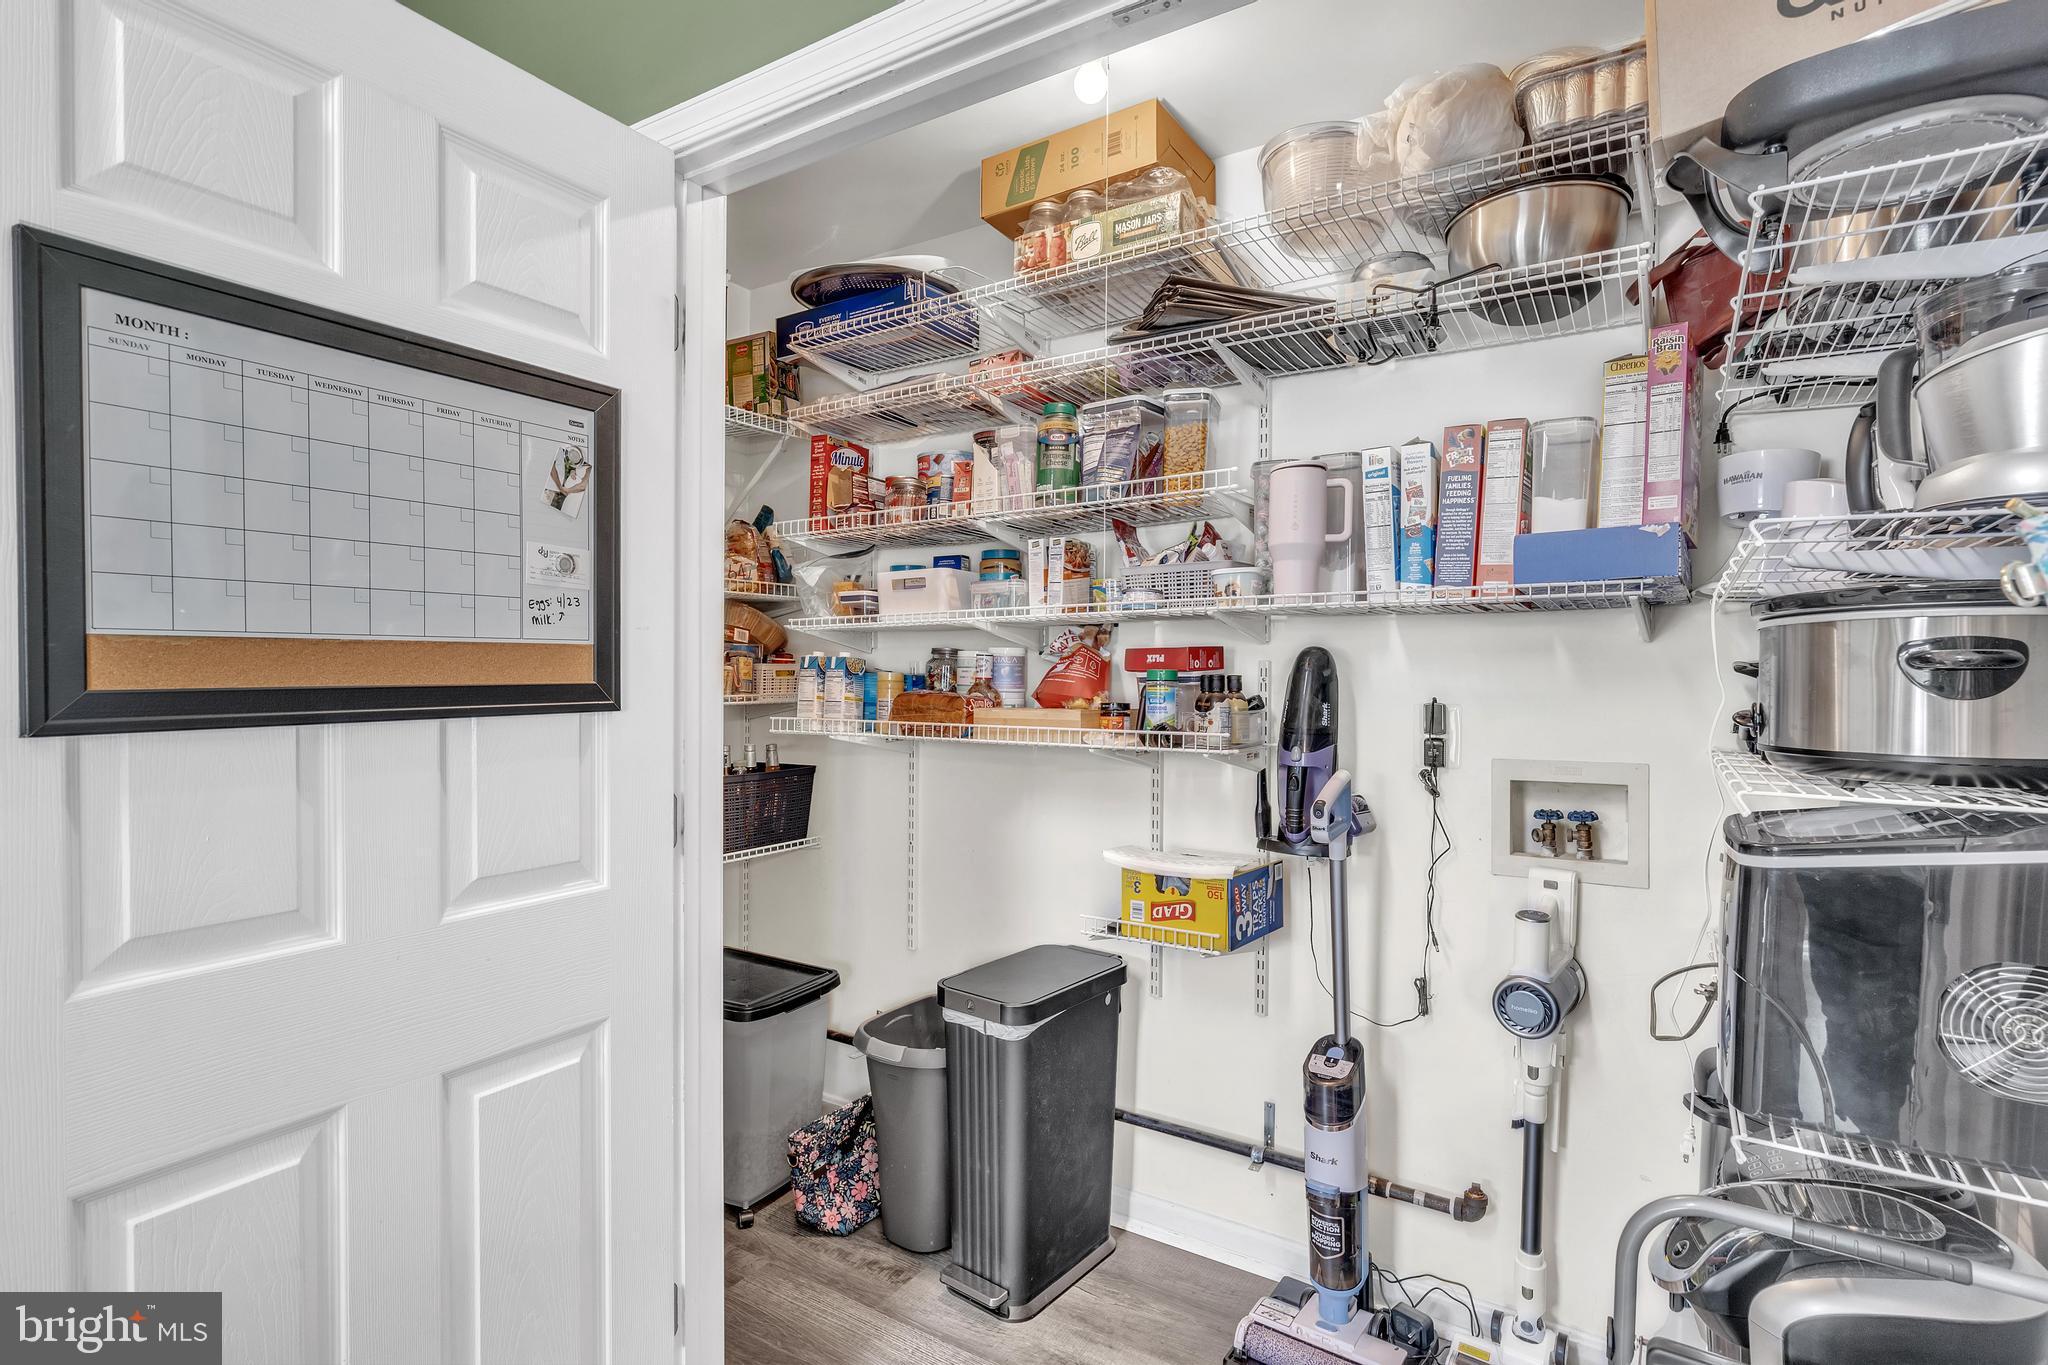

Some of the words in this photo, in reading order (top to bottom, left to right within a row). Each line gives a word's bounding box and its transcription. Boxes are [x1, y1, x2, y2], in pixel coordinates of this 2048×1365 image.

[1071, 147, 1079, 168] 100
[1115, 217, 1140, 235] MASON
[1143, 212, 1162, 226] JARS
[1074, 229, 1098, 252] Ball
[818, 312, 842, 324] EVERYDAY
[114, 313, 180, 338] MONTH
[108, 336, 150, 351] SUNDAY
[1652, 336, 1685, 348] Raisin
[1656, 344, 1681, 354] Bran
[186, 353, 227, 368] MONDAY
[1610, 360, 1646, 372] Cheerios
[256, 368, 296, 382] TUESDAY
[314, 380, 364, 397] WEDNESDAY
[376, 394, 416, 408] THURSDAY
[436, 407, 461, 418] FRIDAY
[480, 416, 512, 428] SATURDAY
[568, 435, 584, 444] NOTES
[831, 450, 865, 468] Minute
[1723, 472, 1762, 485] HAWAIIAN
[1207, 890, 1224, 900] 150
[1152, 903, 1193, 919] GLAD
[1310, 1152, 1338, 1165] Shark
